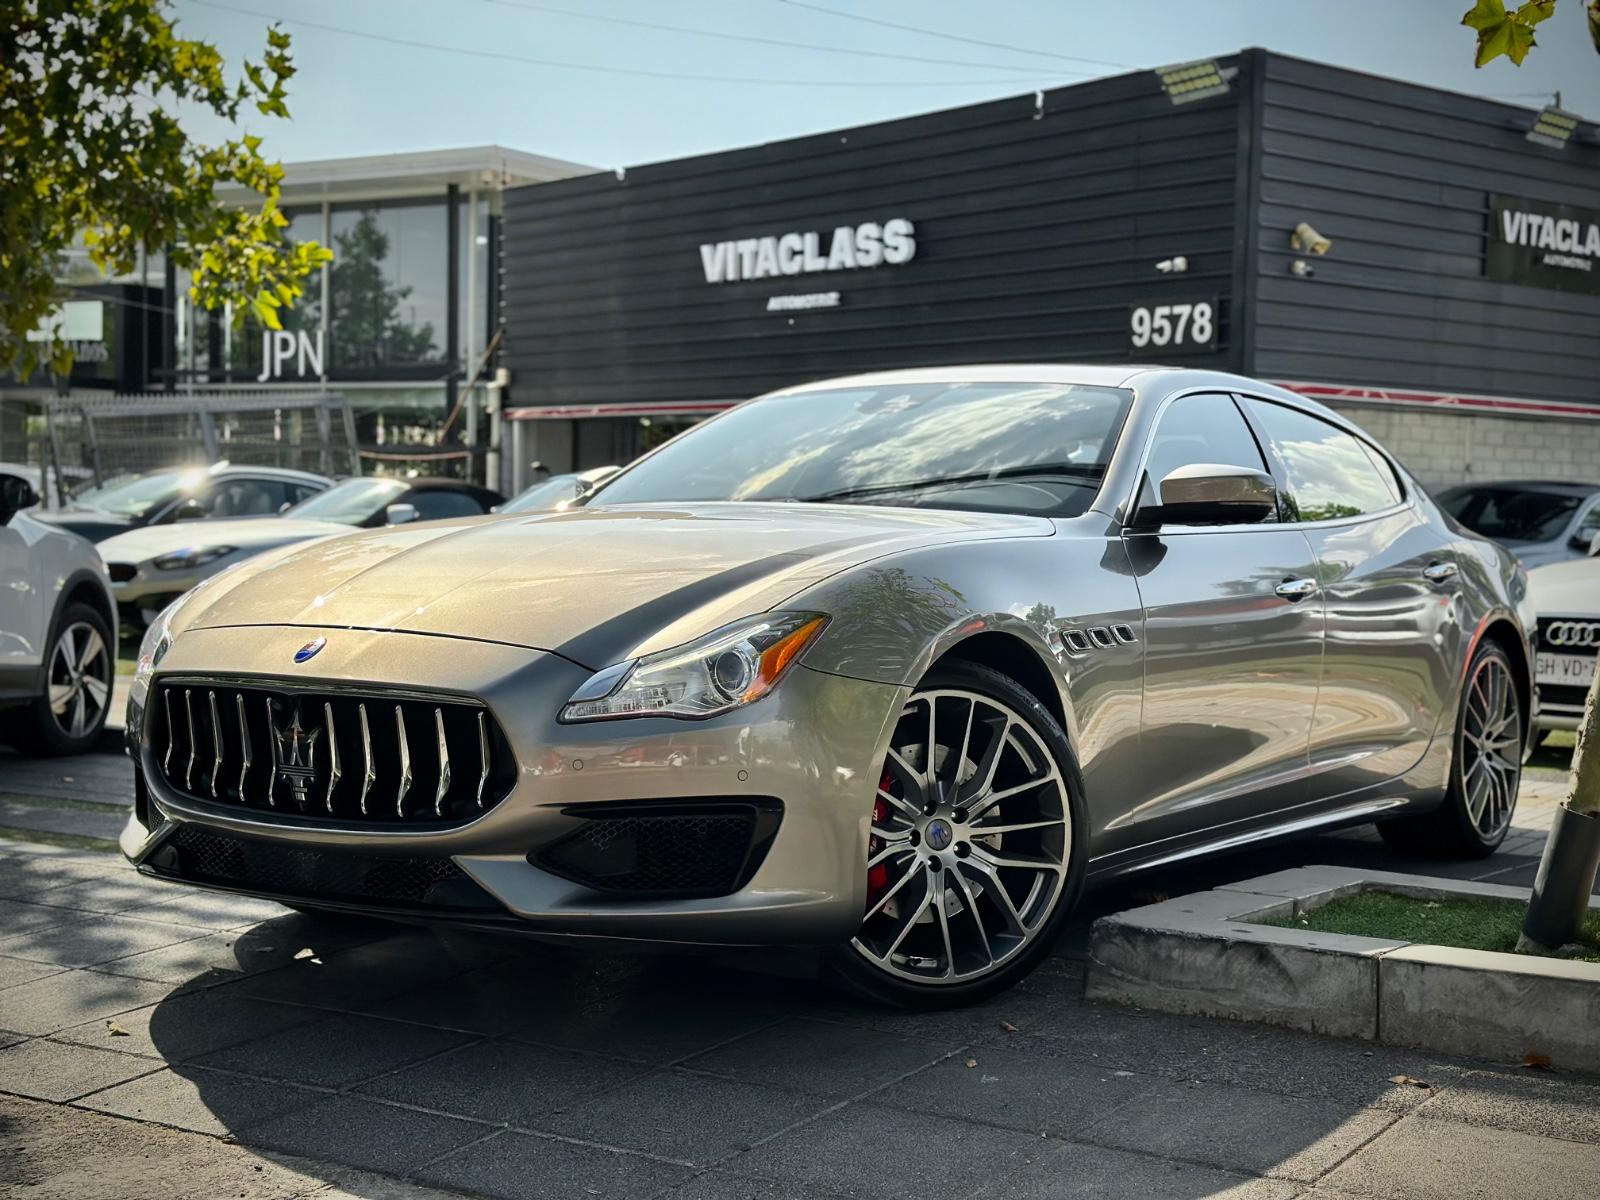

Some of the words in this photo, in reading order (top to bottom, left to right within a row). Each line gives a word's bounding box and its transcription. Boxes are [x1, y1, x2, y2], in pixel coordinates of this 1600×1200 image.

[699, 218, 916, 283] VITACLASS
[1503, 209, 1600, 258] VITACLA
[1131, 302, 1213, 347] 9578
[257, 329, 323, 382] JPN
